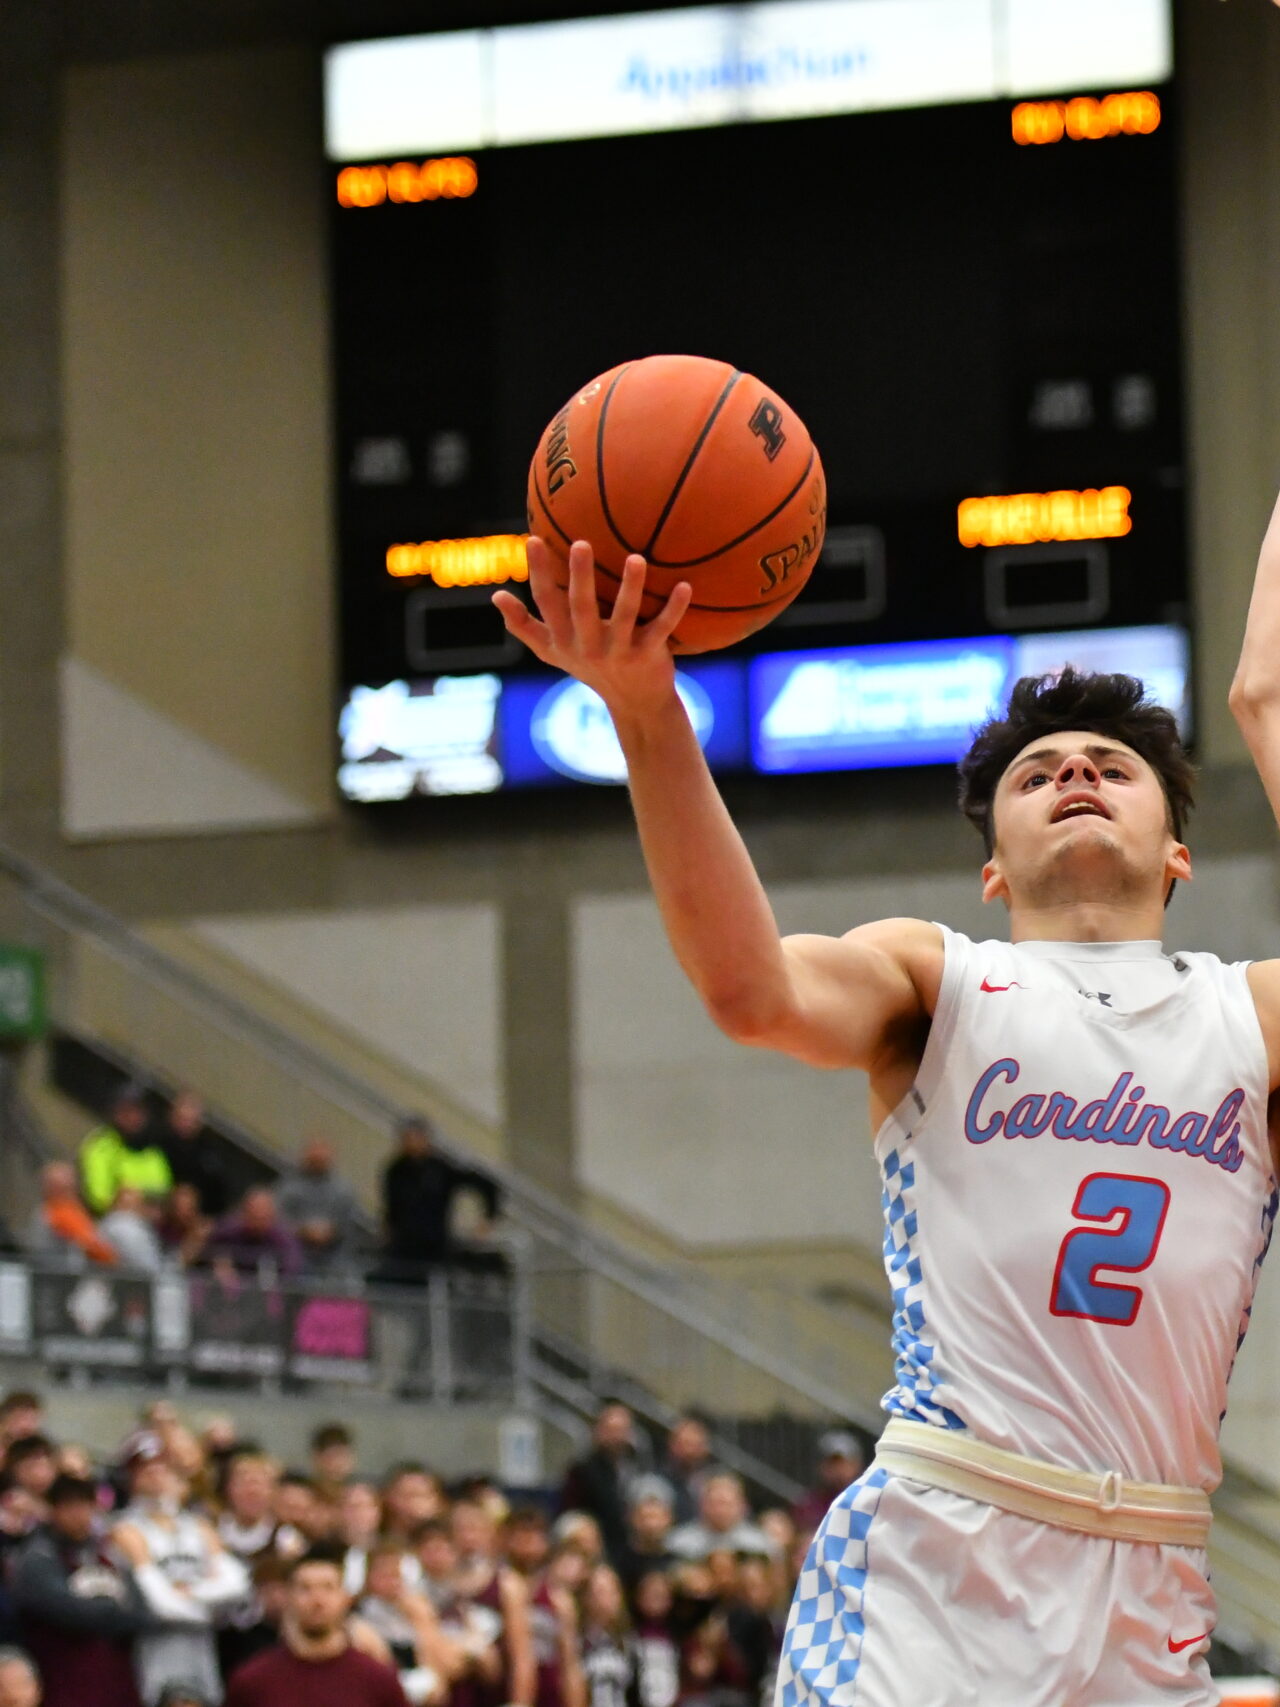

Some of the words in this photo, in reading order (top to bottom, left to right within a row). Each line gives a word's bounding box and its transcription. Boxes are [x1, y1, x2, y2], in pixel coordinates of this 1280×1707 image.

[748, 396, 787, 463] P
[964, 1057, 1245, 1173] Cardinals
[1049, 1171, 1172, 1327] 2
